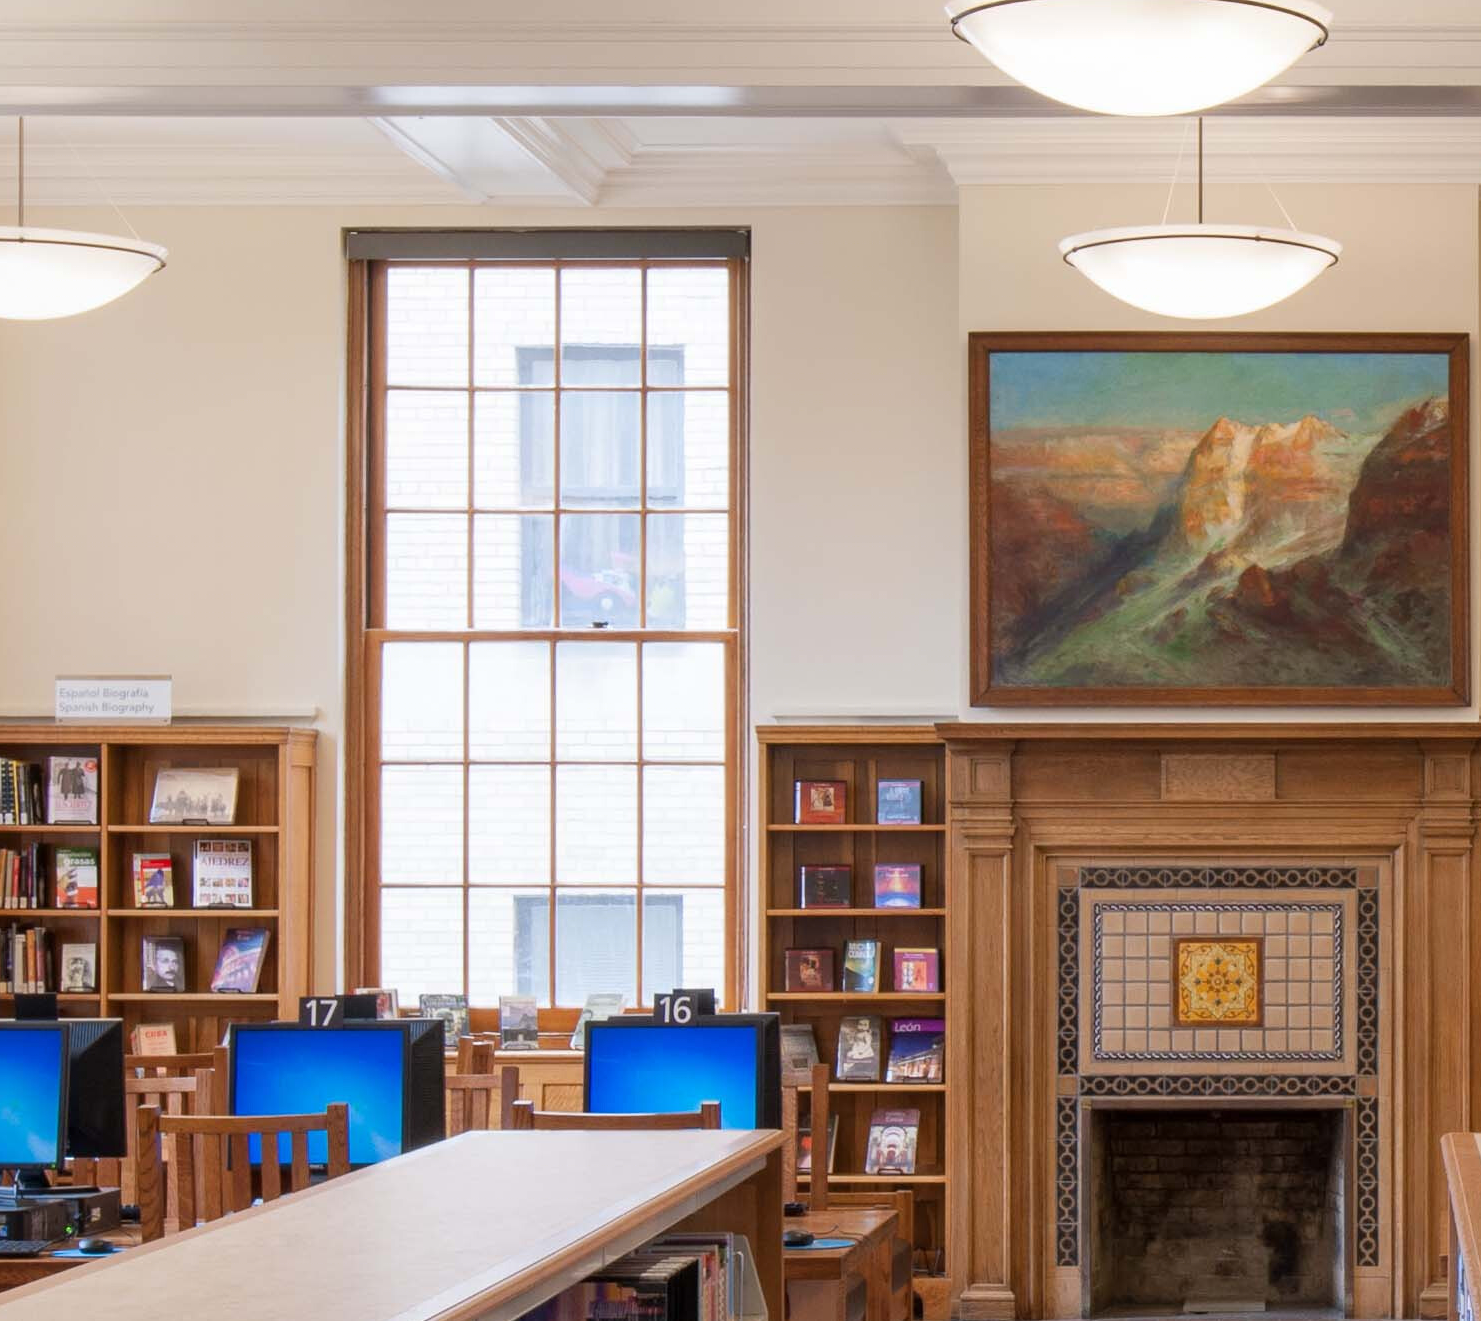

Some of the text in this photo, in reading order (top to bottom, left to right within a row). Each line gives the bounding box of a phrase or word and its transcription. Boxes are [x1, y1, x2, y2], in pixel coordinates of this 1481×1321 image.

[59, 687, 149, 699] Español Biografía
[59, 702, 155, 714] Spanish Biography
[305, 999, 338, 1028] 17
[659, 996, 693, 1025] 16
[894, 1022, 921, 1032] León
